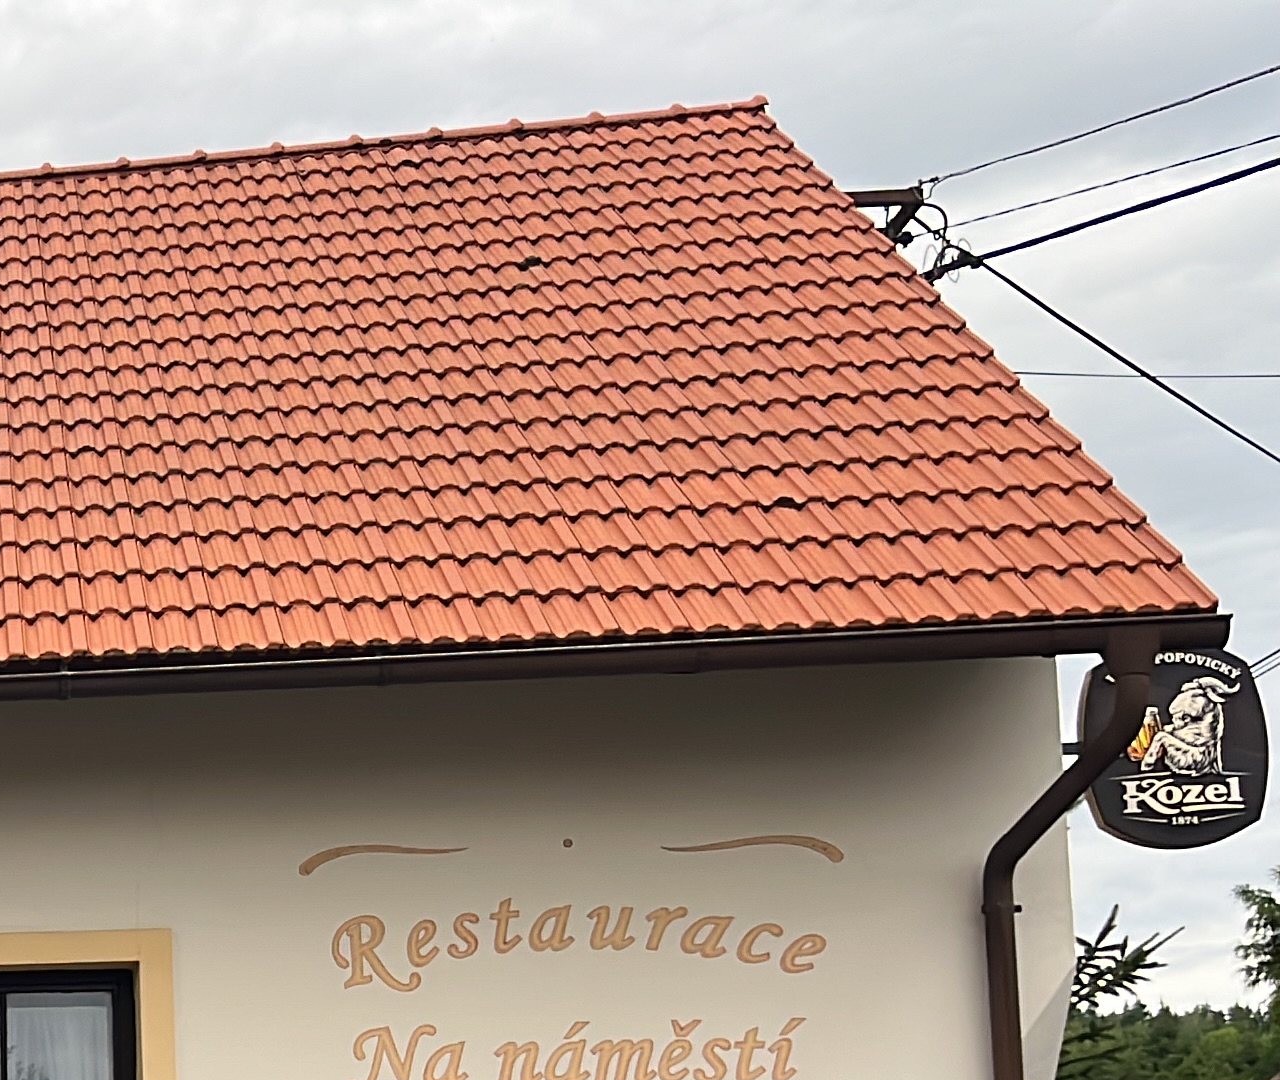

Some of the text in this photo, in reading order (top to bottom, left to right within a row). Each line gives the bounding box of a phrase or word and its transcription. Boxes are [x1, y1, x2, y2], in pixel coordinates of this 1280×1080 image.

[1154, 652, 1242, 680] POPOVICKÝ
[1121, 777, 1244, 815] Kozel
[1171, 816, 1198, 825] 1874
[331, 897, 827, 991] Restaurace
